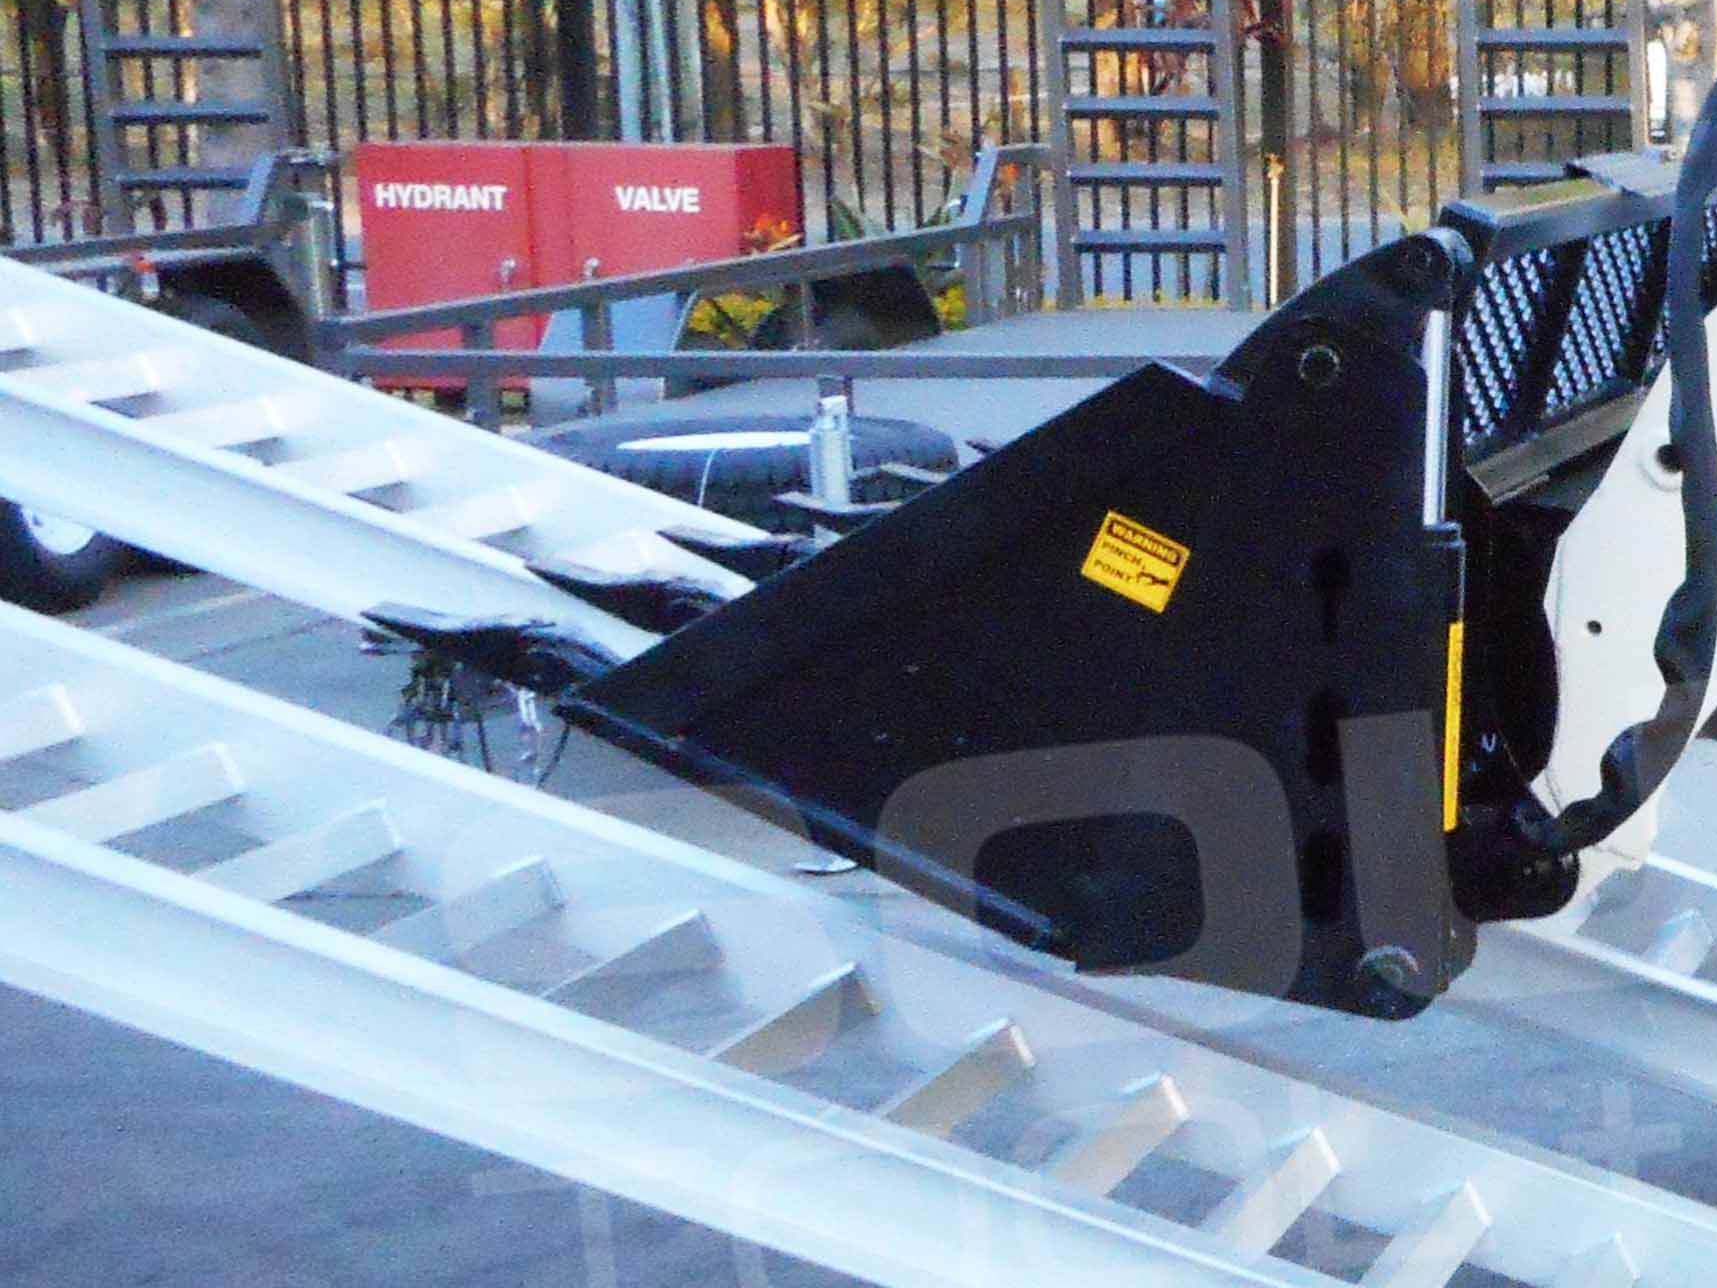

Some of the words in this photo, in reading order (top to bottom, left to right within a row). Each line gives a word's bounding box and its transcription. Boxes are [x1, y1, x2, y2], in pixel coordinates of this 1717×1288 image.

[374, 182, 508, 211] HYDRANT
[614, 184, 701, 214] VALVE
[1111, 522, 1178, 566] WARNING
